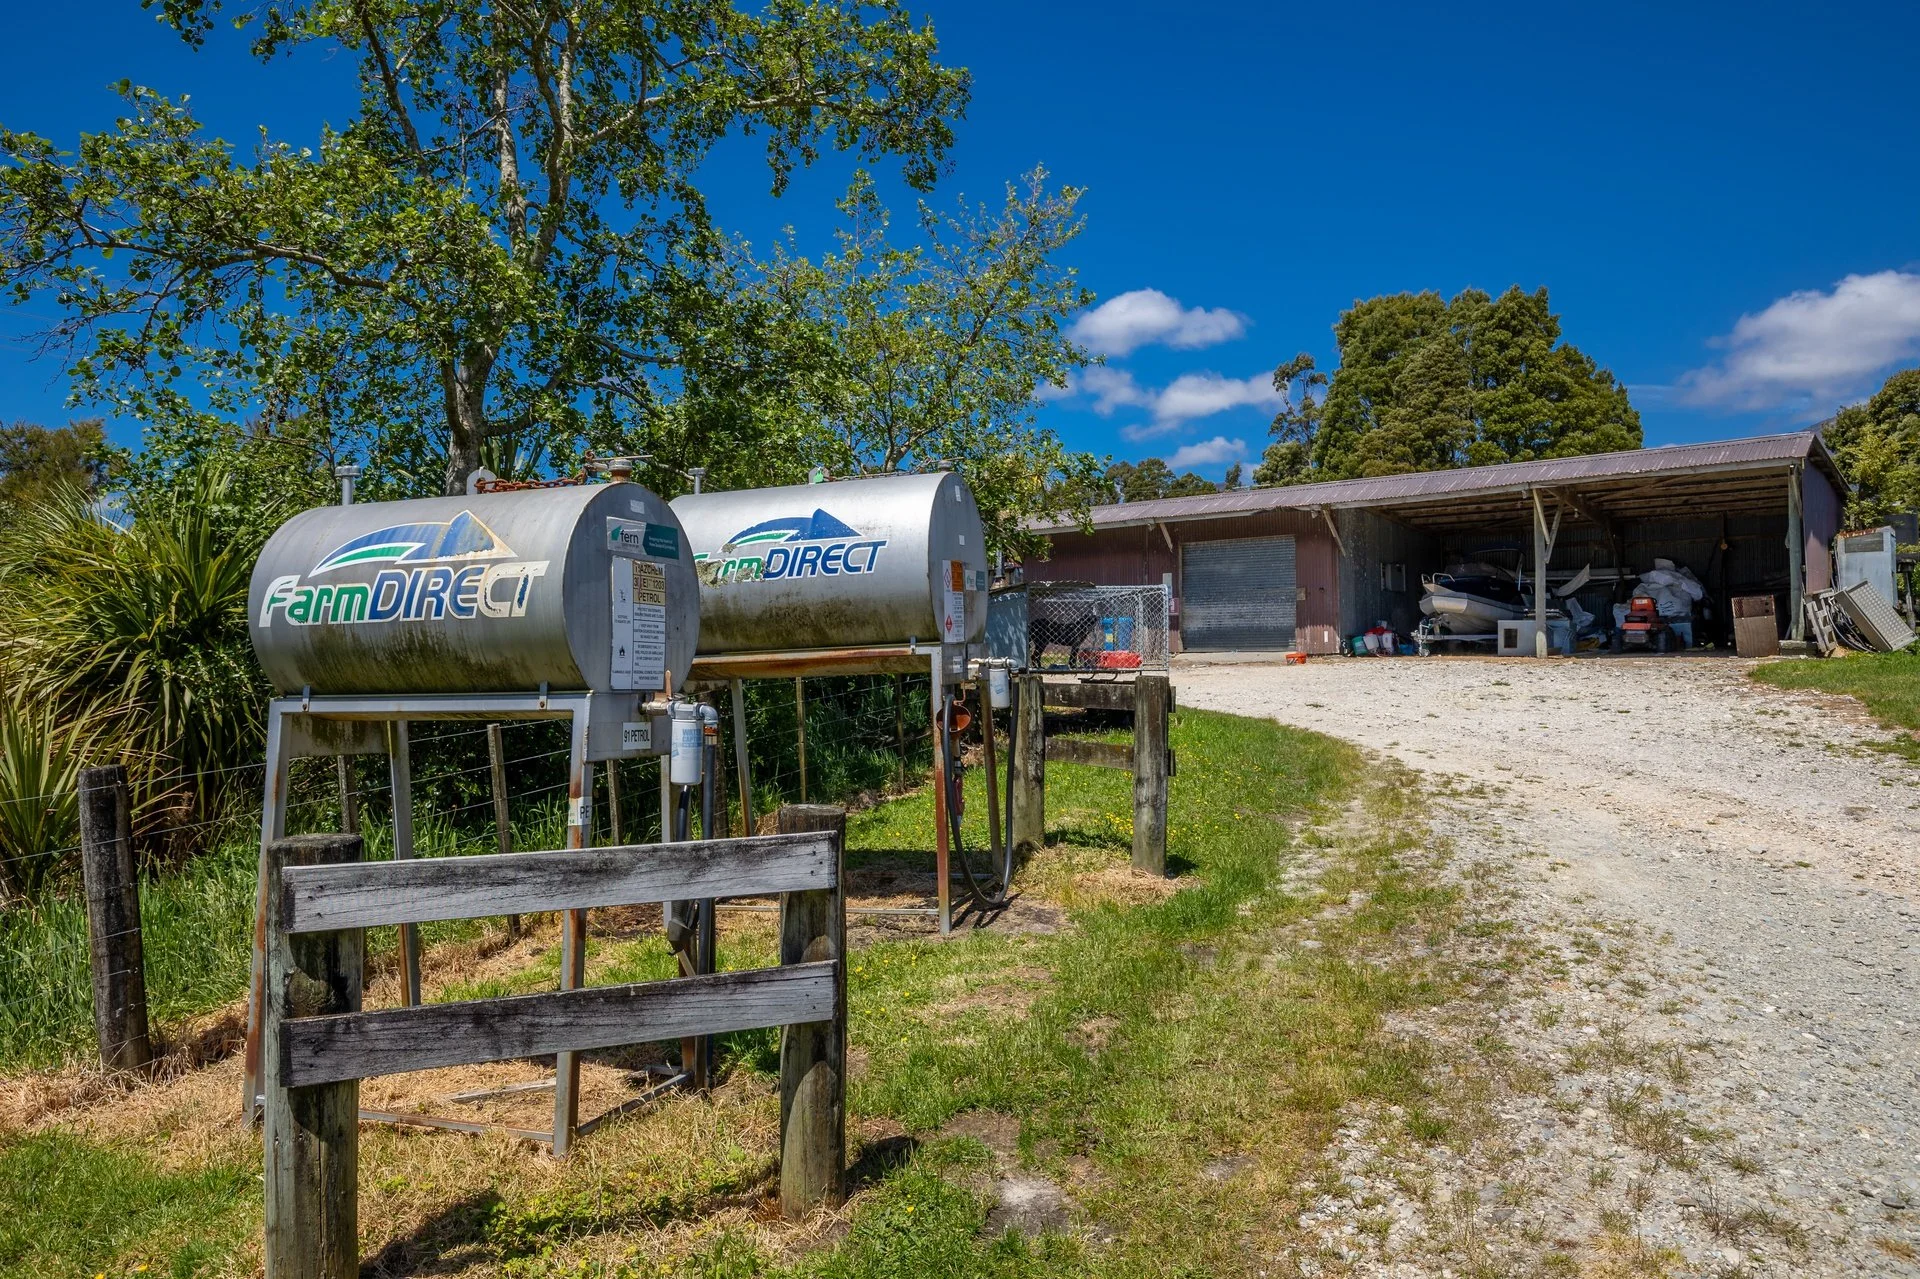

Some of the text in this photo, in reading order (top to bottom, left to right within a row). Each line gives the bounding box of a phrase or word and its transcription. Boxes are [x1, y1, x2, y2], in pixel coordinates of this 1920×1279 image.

[620, 529, 639, 544] fern
[638, 592, 661, 604] PETROL
[623, 729, 650, 743] 91 PETROL
